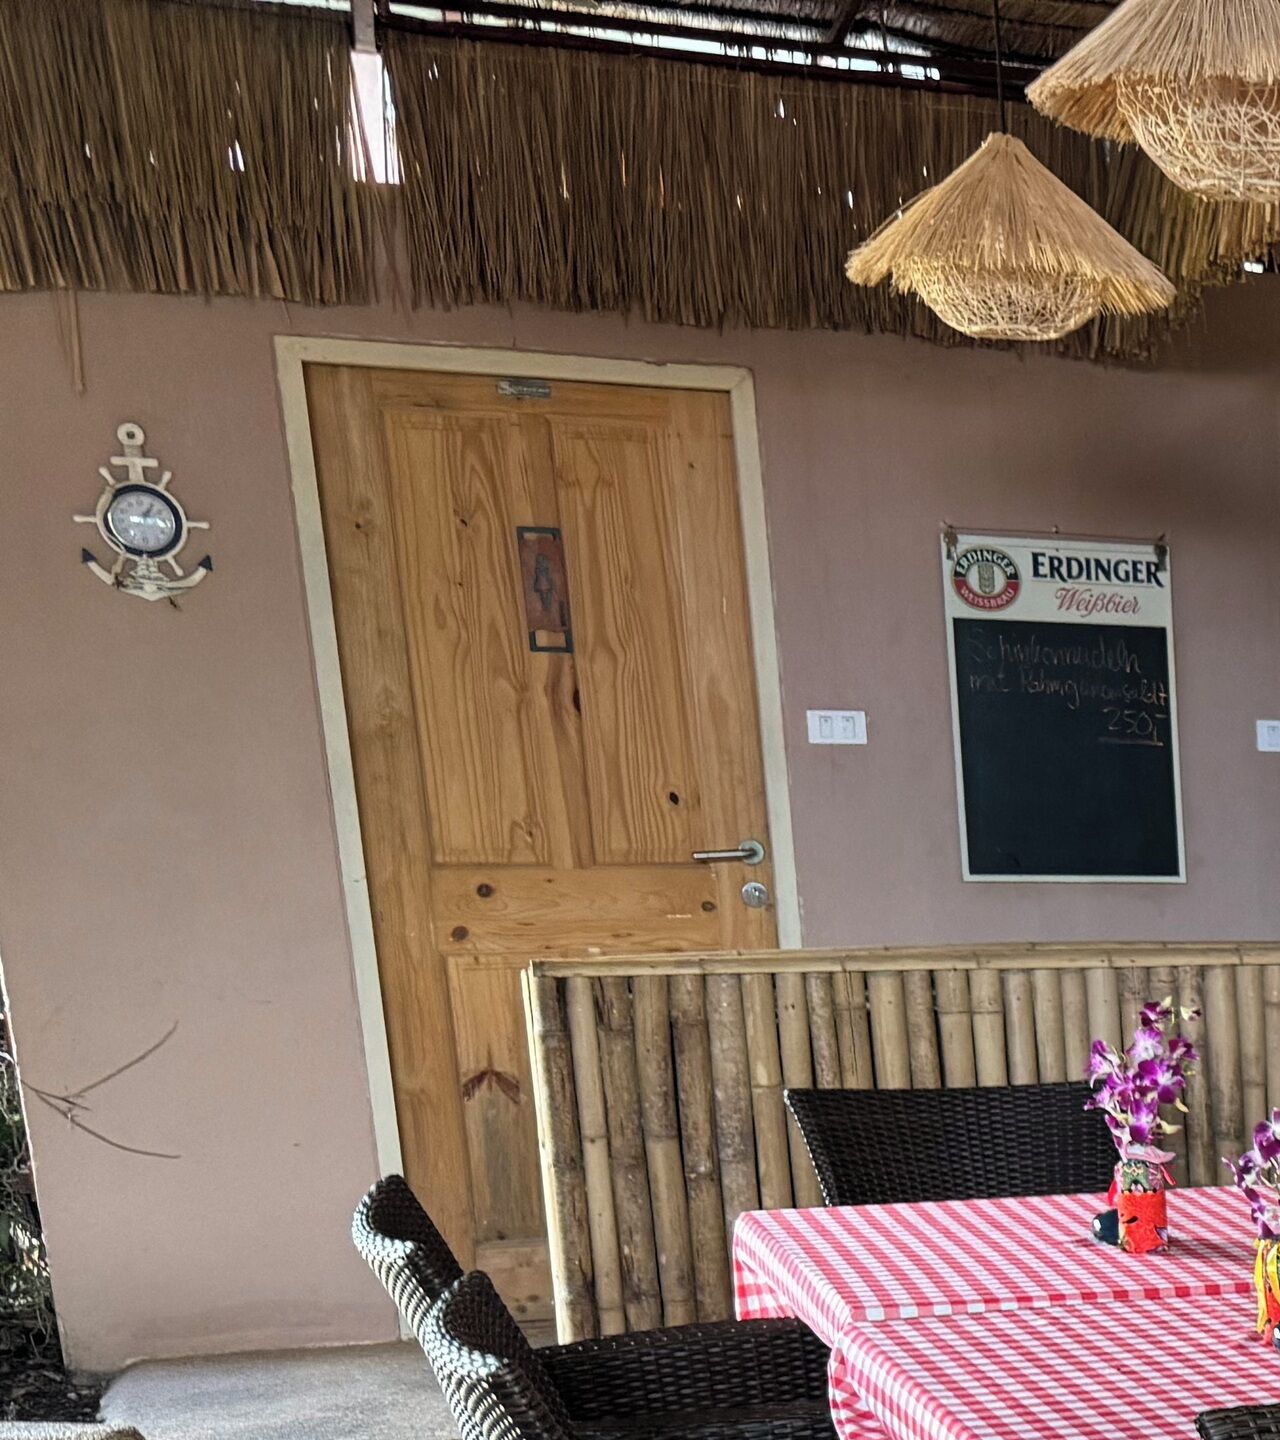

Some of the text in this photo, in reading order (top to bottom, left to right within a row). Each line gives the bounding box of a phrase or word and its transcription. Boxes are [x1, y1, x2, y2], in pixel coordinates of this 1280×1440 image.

[956, 550, 1017, 576] ERDINGER
[1031, 551, 1165, 588] ERDINGER
[1055, 587, 1141, 618] Weißbier
